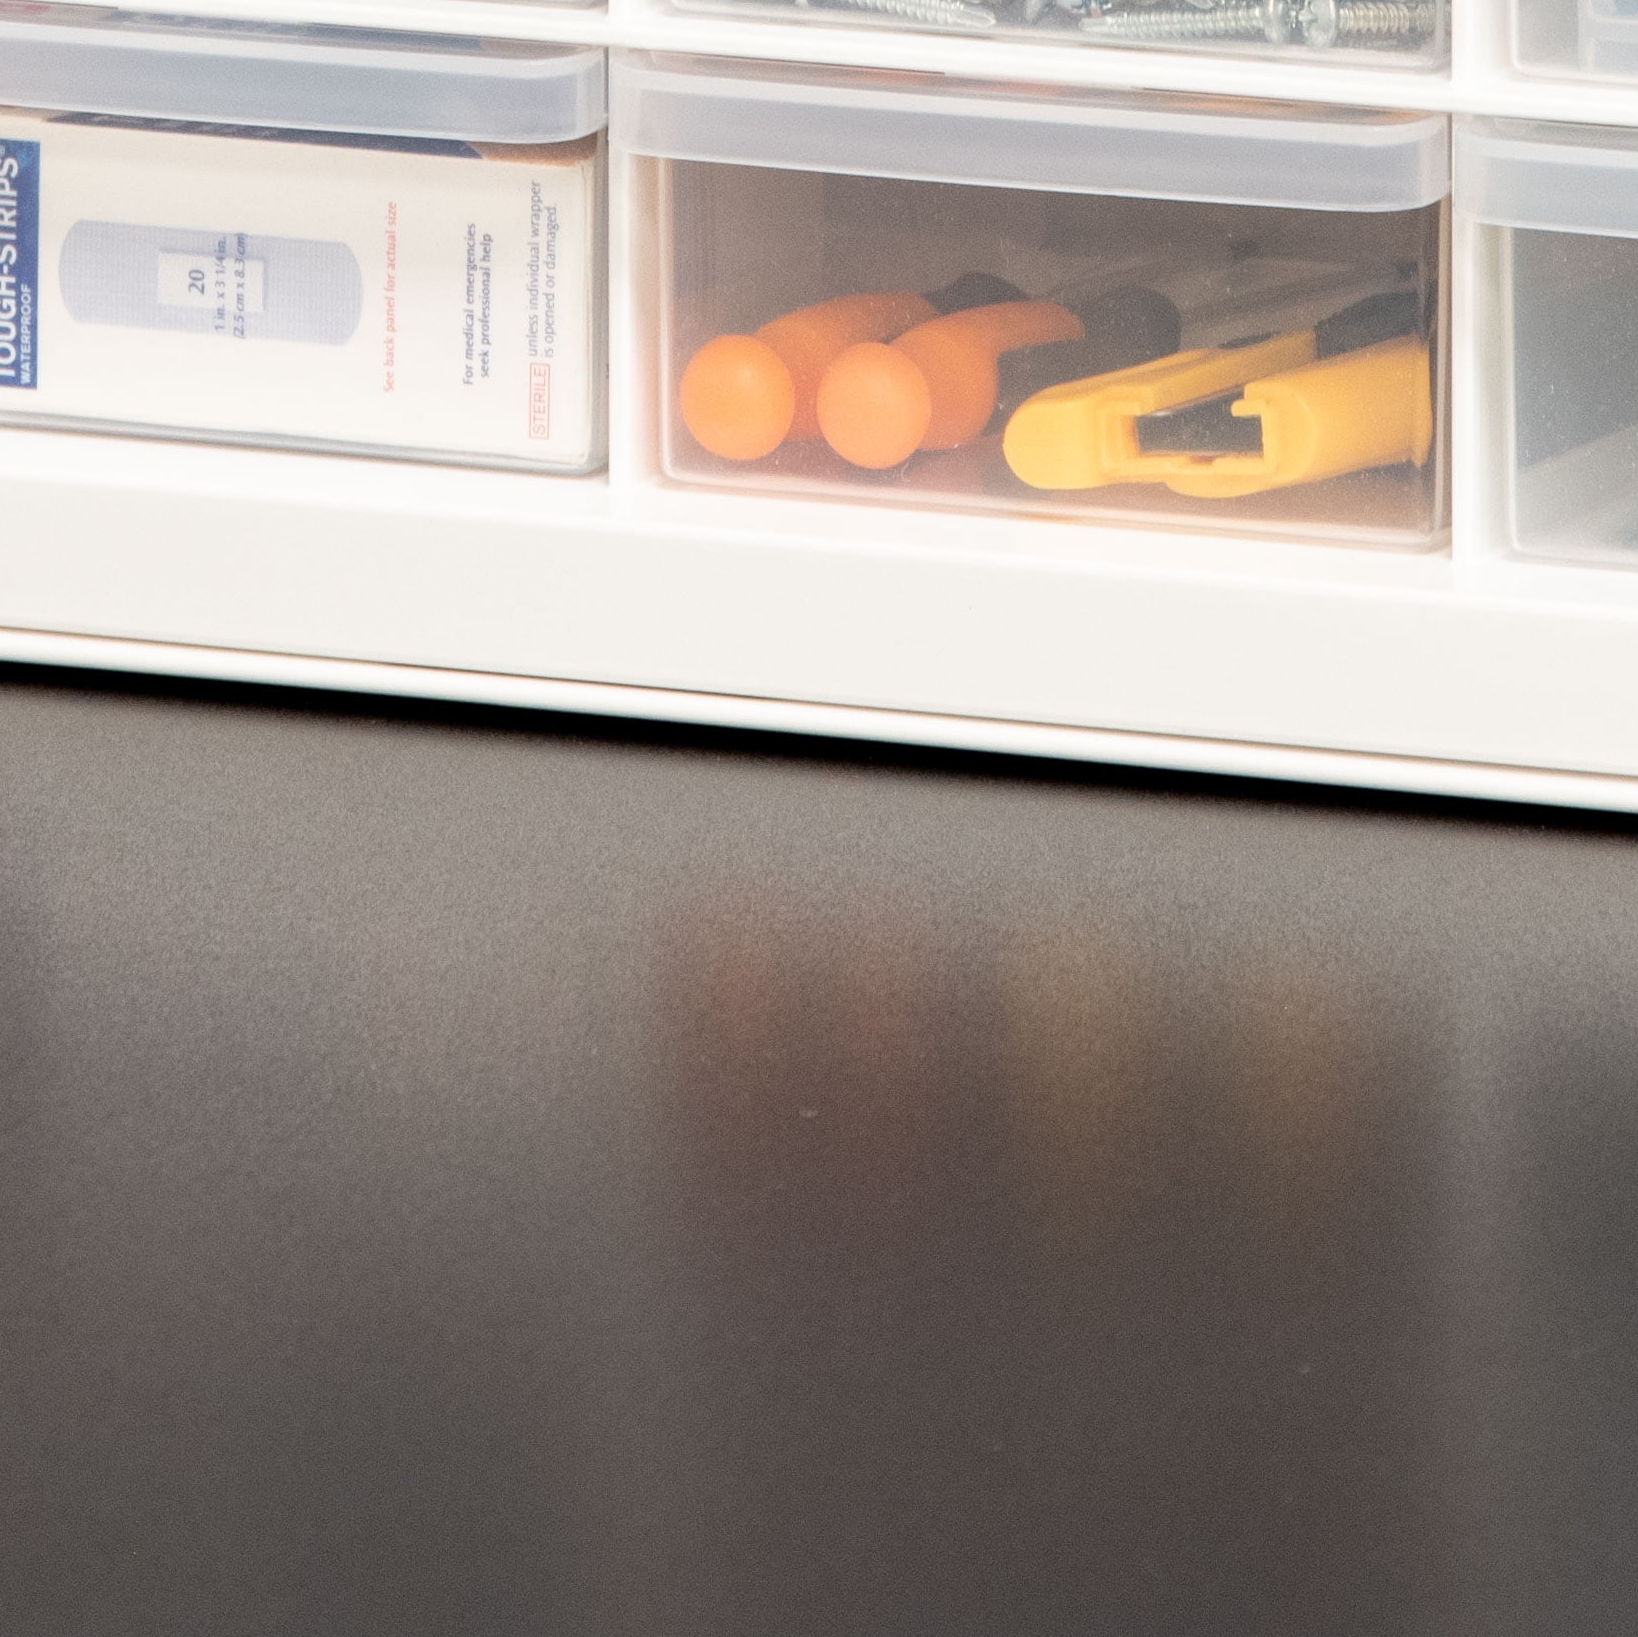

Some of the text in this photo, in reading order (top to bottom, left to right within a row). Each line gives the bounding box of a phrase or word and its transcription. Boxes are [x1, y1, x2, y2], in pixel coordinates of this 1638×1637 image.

[20, 283, 32, 385] WATERPROOF
[188, 269, 205, 296] 20
[236, 293, 245, 312] cm
[383, 201, 397, 393] See back panel for actual size
[462, 223, 478, 386] For medical emergencies
[478, 233, 494, 378] seek professional help
[527, 180, 543, 357] unless individual wrapper
[543, 204, 559, 358] is opened or damaged.
[533, 366, 546, 435] STERILE
